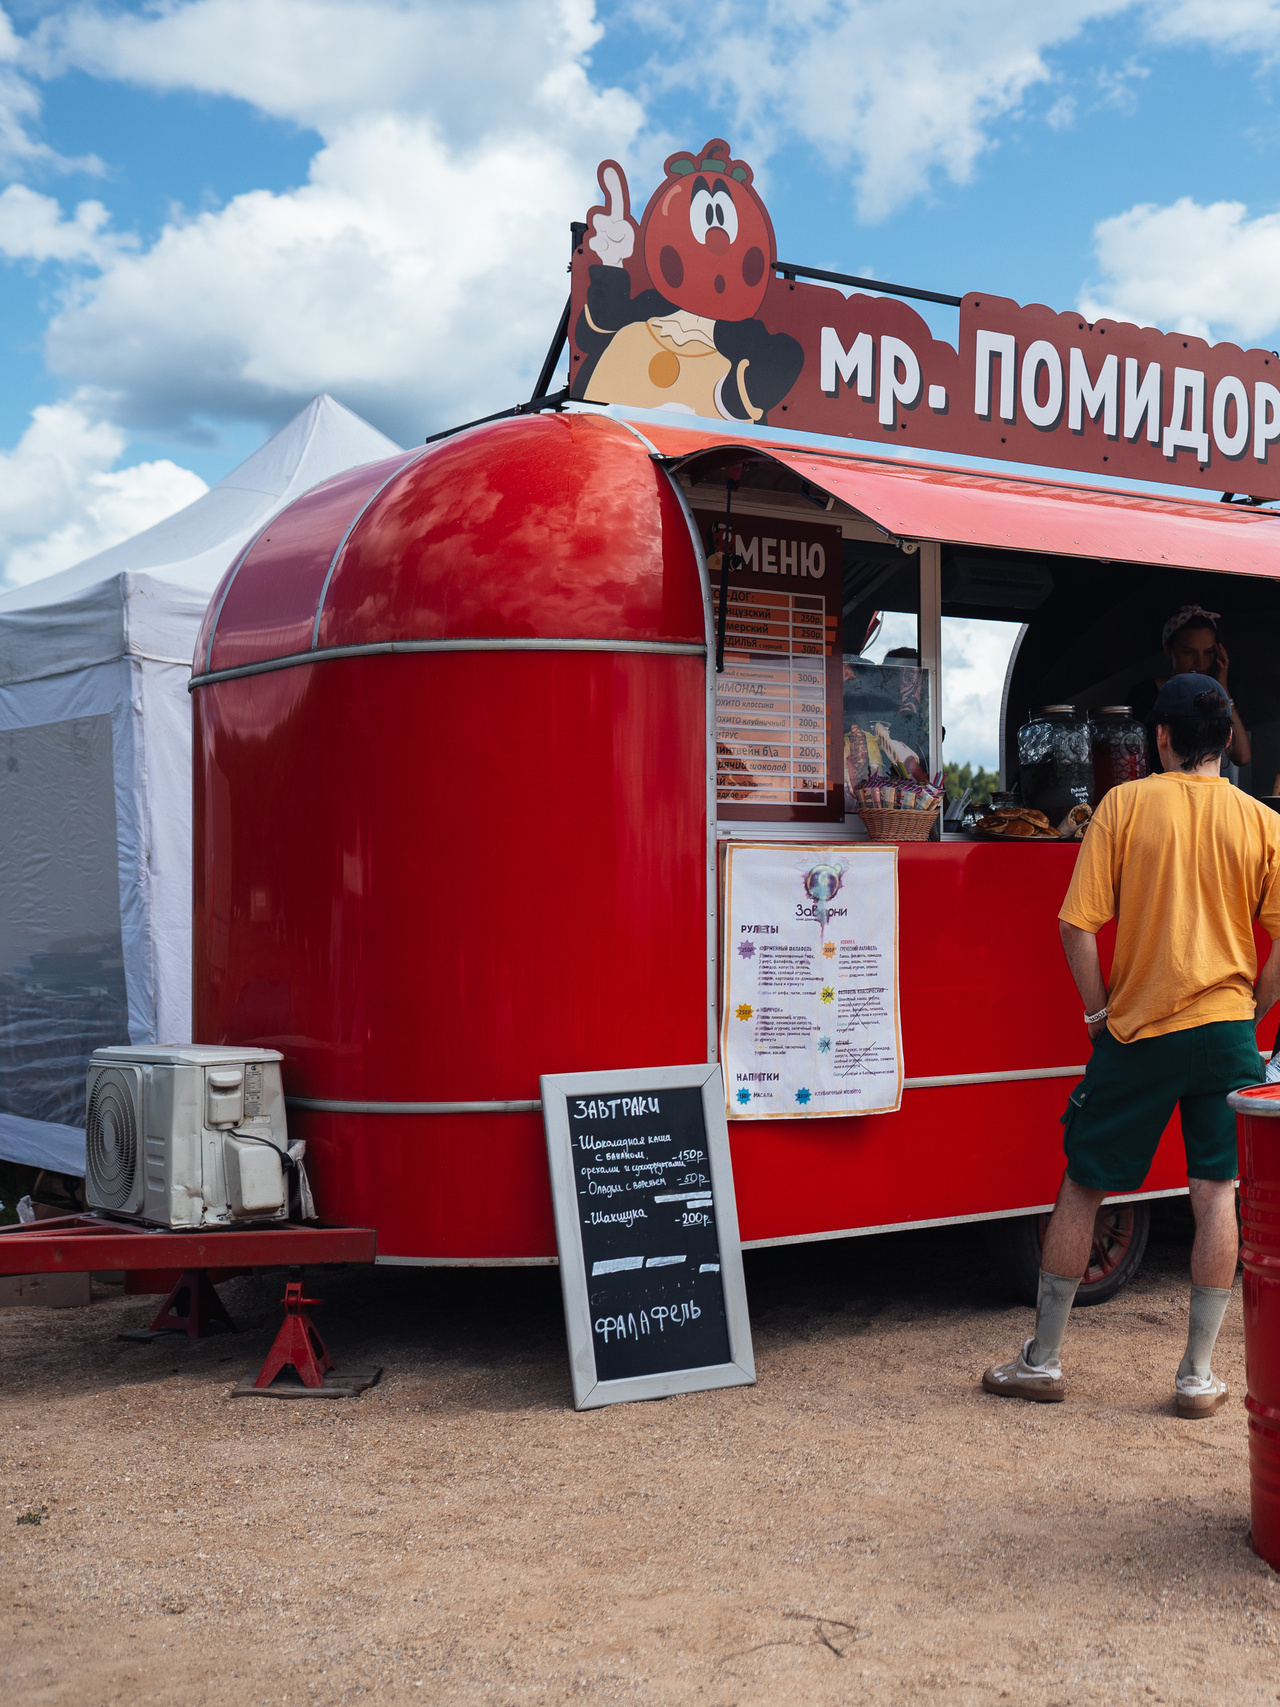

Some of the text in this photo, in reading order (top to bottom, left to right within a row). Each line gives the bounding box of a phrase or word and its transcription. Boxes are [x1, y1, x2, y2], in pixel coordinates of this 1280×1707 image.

[734, 534, 826, 579] МЕНЮ
[801, 614, 822, 624] 250р.
[801, 629, 823, 639] 250р.
[798, 673, 820, 684] 300р.
[717, 682, 767, 696] ИМОНАД:
[716, 699, 823, 714] ОХИТО классика 200р.
[716, 716, 820, 729] ОХИТО клубничный 200р.
[799, 733, 820, 743] 200р.
[799, 747, 823, 758] 200р.
[717, 759, 819, 773] рячий шоколад 100р.
[803, 778, 820, 789] 50р.
[741, 925, 779, 934] РУЛЕТЫ
[736, 1073, 780, 1082] НАПИТКИ
[574, 1096, 660, 1119] ЗАВТРАКИ
[648, 1134, 672, 1145] каша
[581, 1166, 620, 1180] орехами
[632, 1160, 686, 1177] сухофруктами
